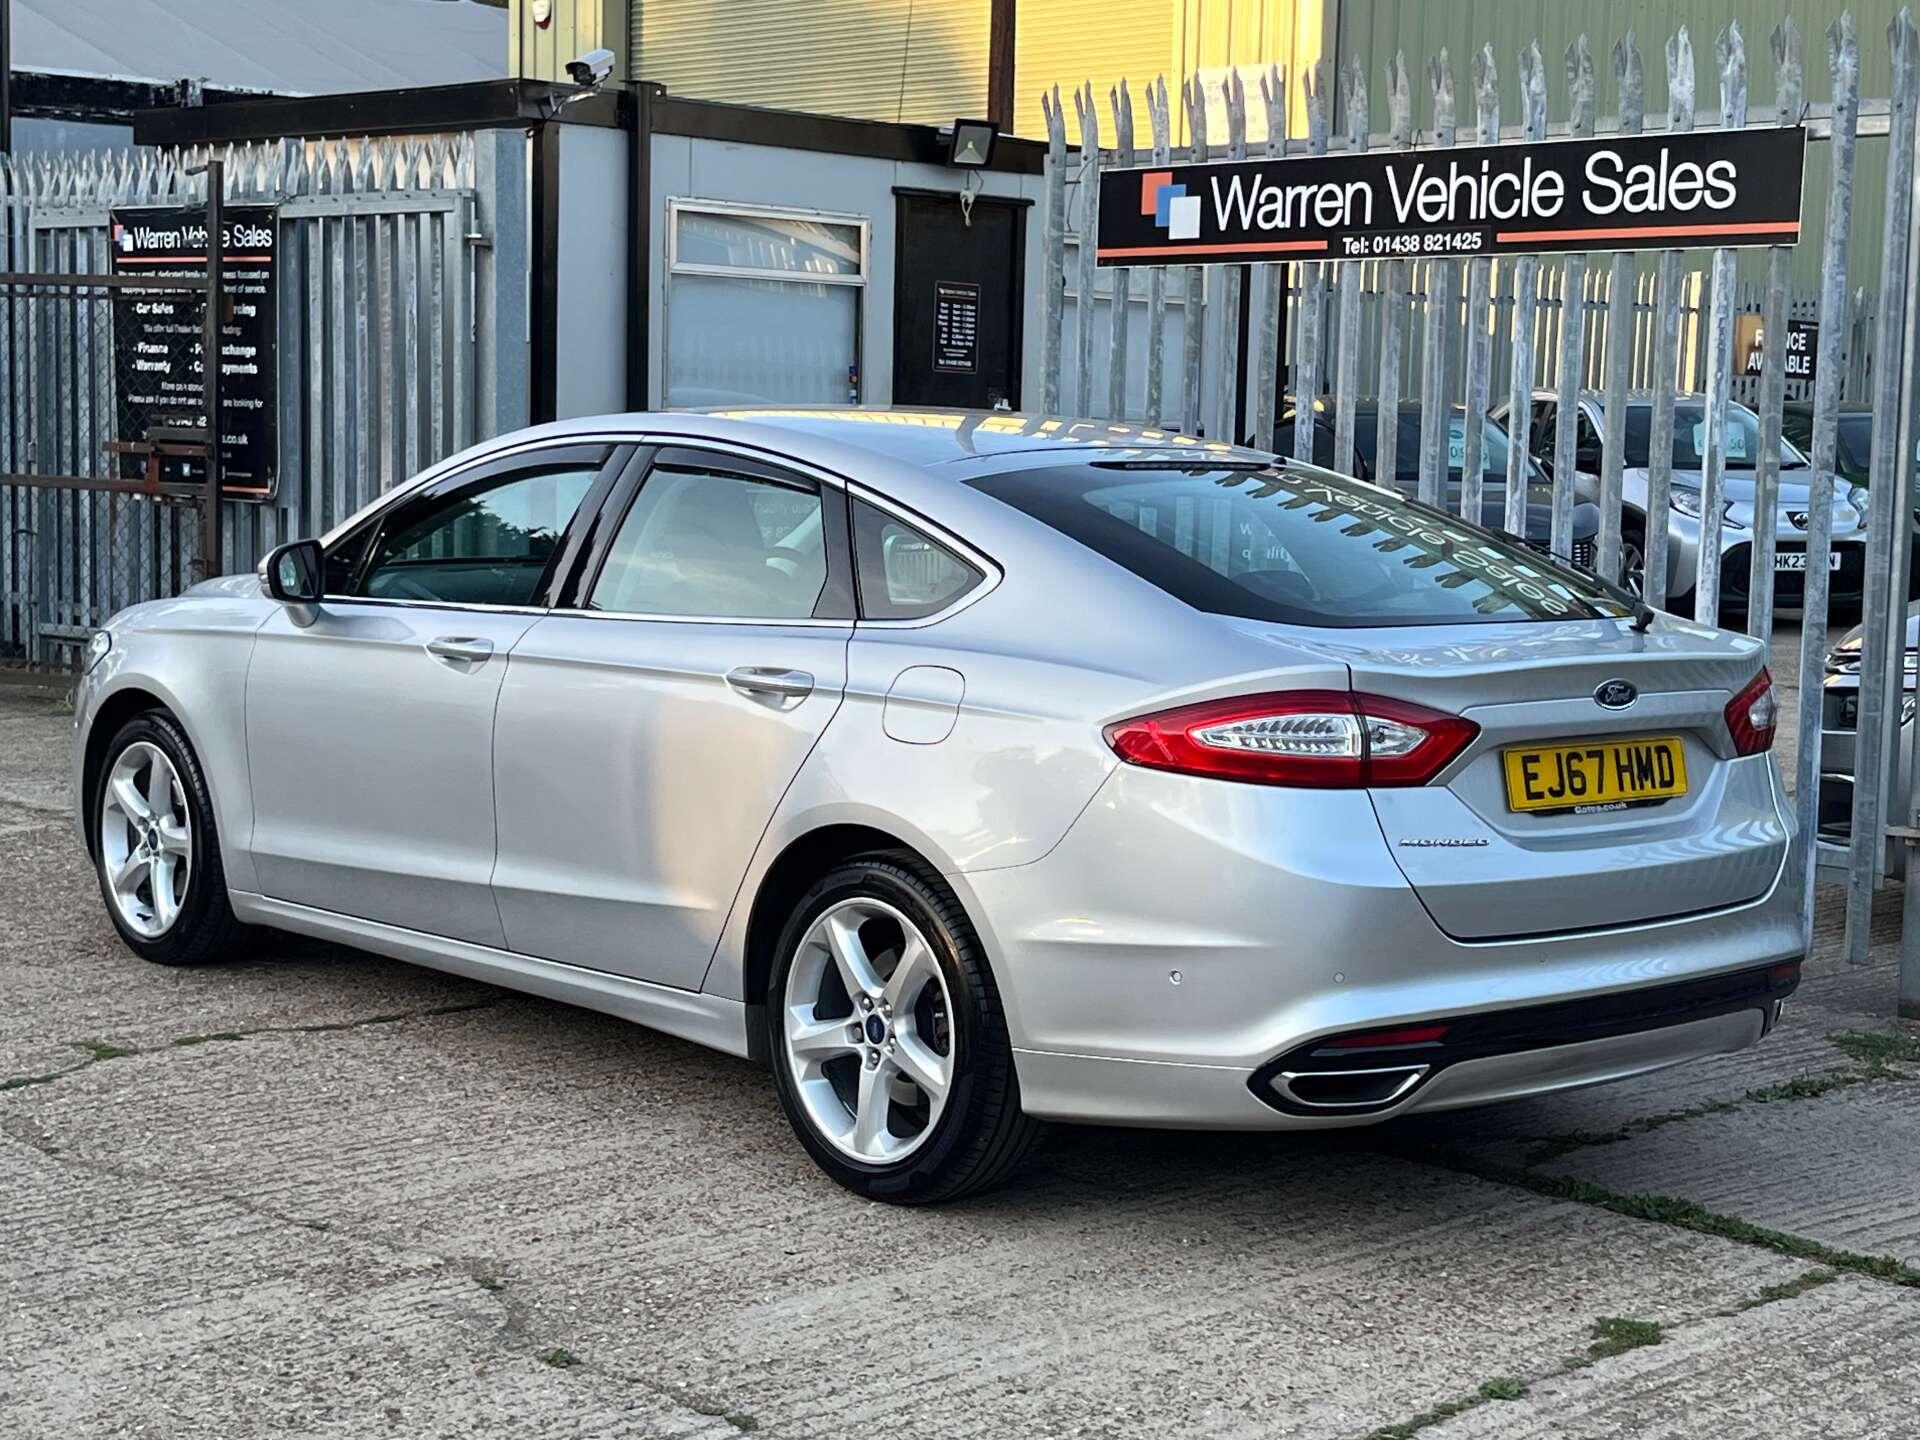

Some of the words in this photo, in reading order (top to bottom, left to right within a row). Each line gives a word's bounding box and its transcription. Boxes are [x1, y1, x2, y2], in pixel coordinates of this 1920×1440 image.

[1209, 172, 1372, 231] Warren
[1385, 156, 1564, 224] Vehicle
[1581, 148, 1737, 214] Sales
[133, 226, 180, 249] Warren
[233, 223, 273, 248] Sales
[1342, 236, 1369, 255] Tel:
[1372, 235, 1420, 254] 01438
[1423, 232, 1482, 252] 821425
[136, 302, 151, 314] Car
[152, 302, 174, 315] Sales
[137, 341, 169, 354] Finance
[135, 359, 171, 374] Warranty
[1522, 749, 1605, 802] EJ67
[1615, 744, 1677, 793] HMD
